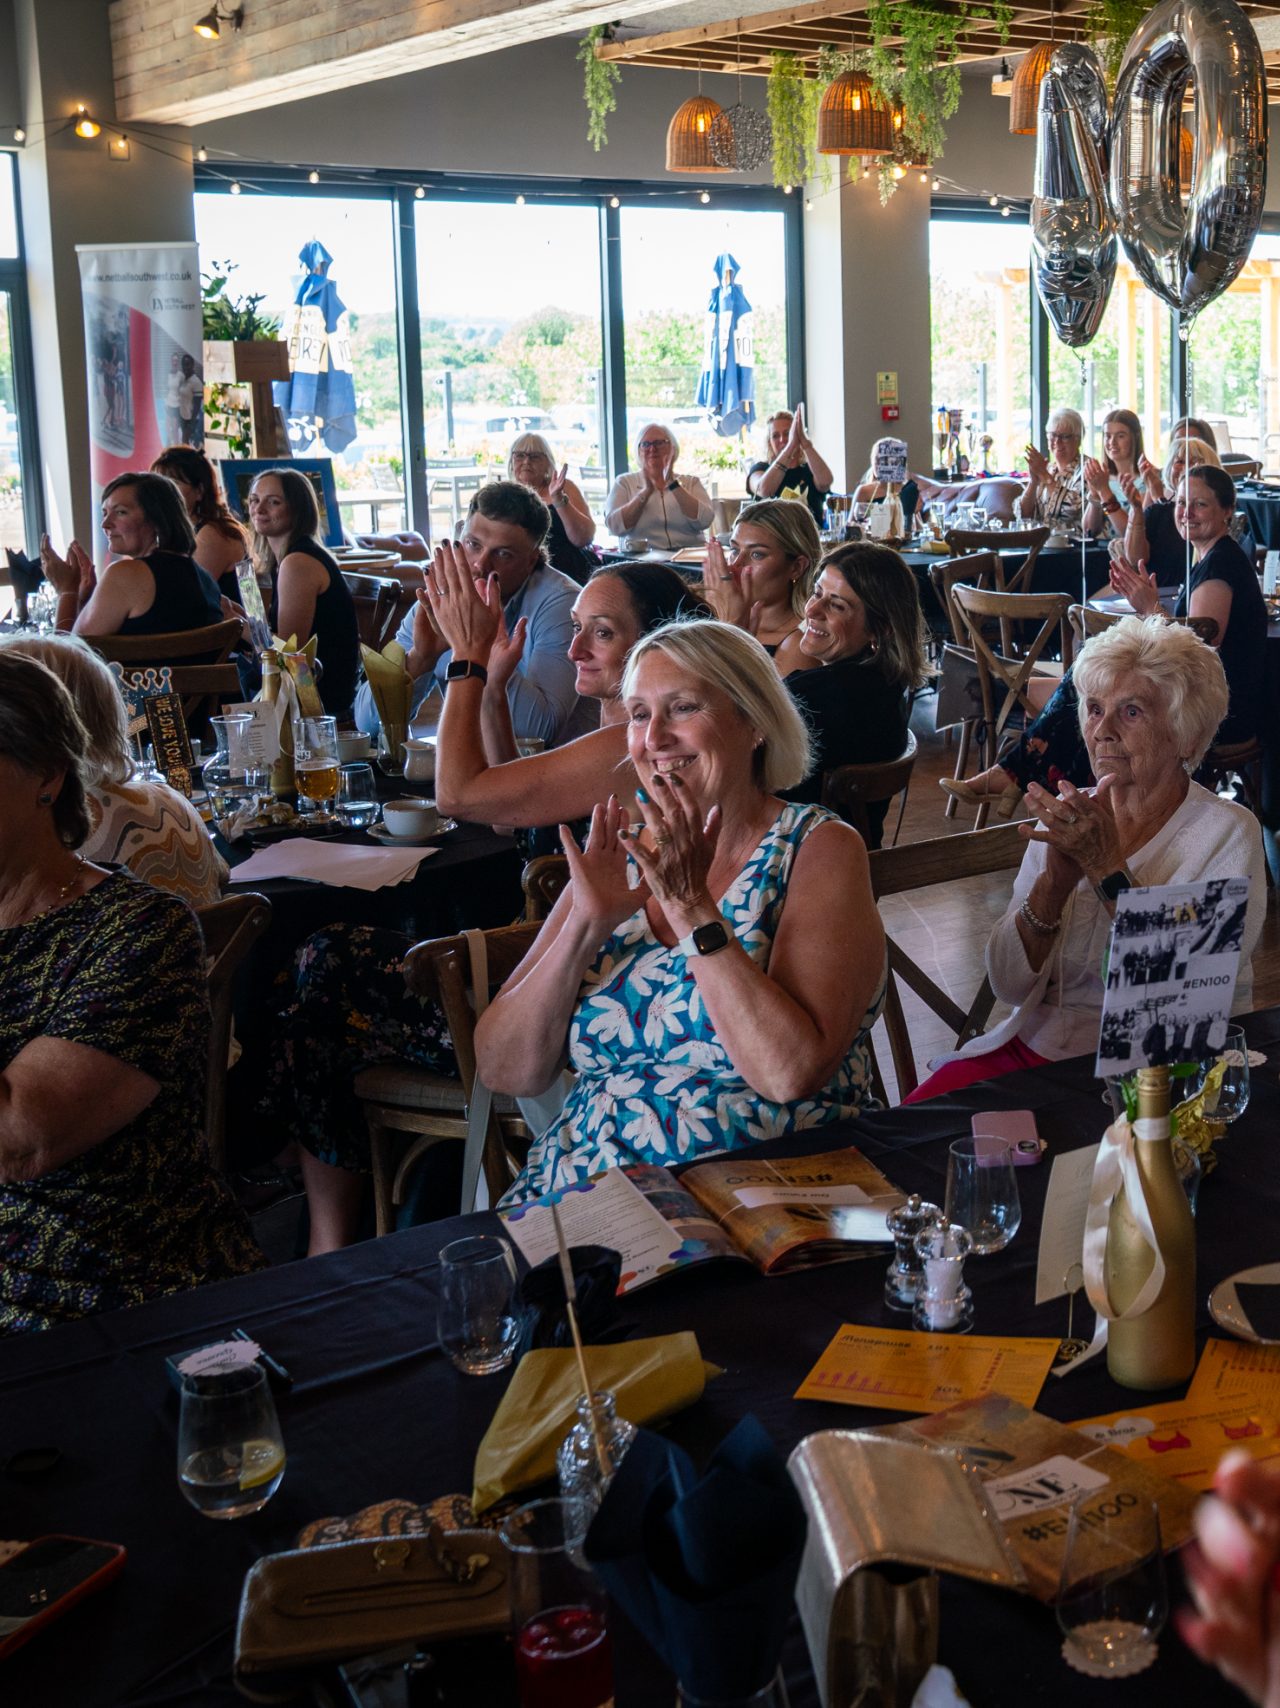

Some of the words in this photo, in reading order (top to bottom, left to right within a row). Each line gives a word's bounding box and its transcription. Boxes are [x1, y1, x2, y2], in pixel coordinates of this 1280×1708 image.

[155, 697, 172, 716] WE
[158, 713, 177, 740] LOVE
[1182, 975, 1230, 990] #EN100
[842, 1334, 911, 1349] Menopause
